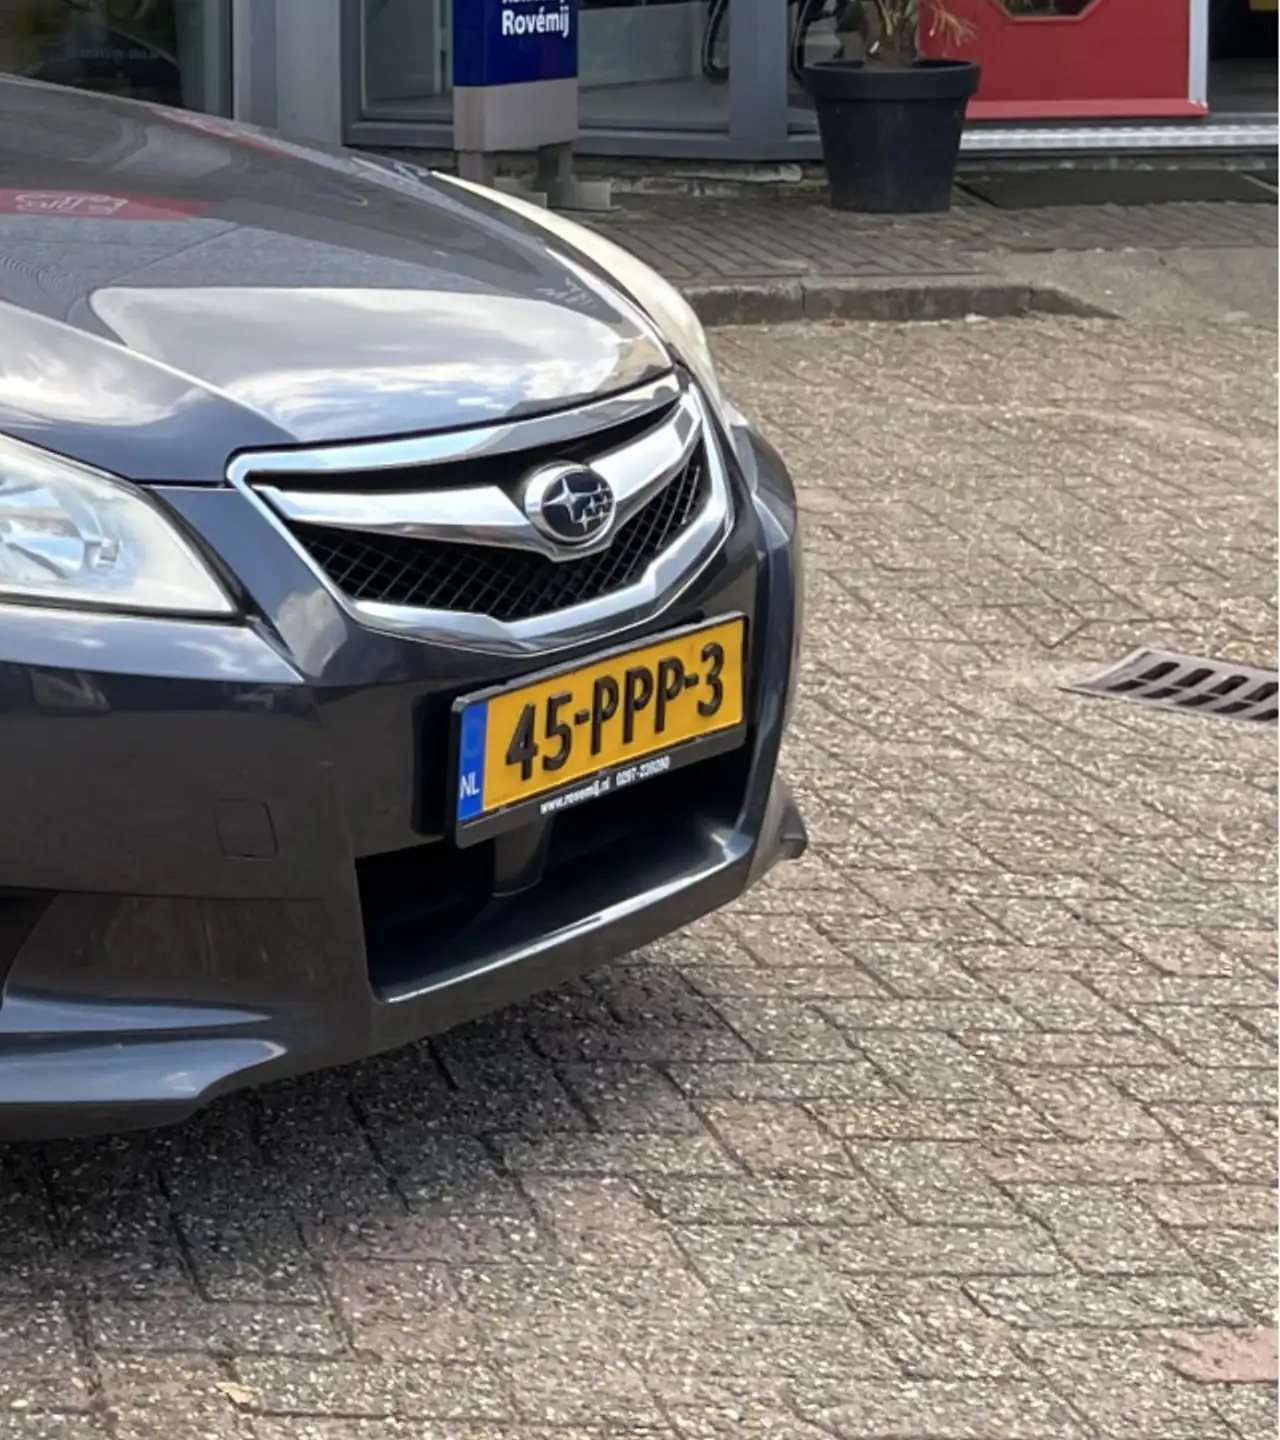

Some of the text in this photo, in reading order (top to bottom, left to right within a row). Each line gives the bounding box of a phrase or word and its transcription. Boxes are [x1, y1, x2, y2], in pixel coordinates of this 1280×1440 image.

[502, 6, 569, 39] Rovémij
[505, 642, 725, 781] 45-PPP-3
[459, 770, 480, 800] NL
